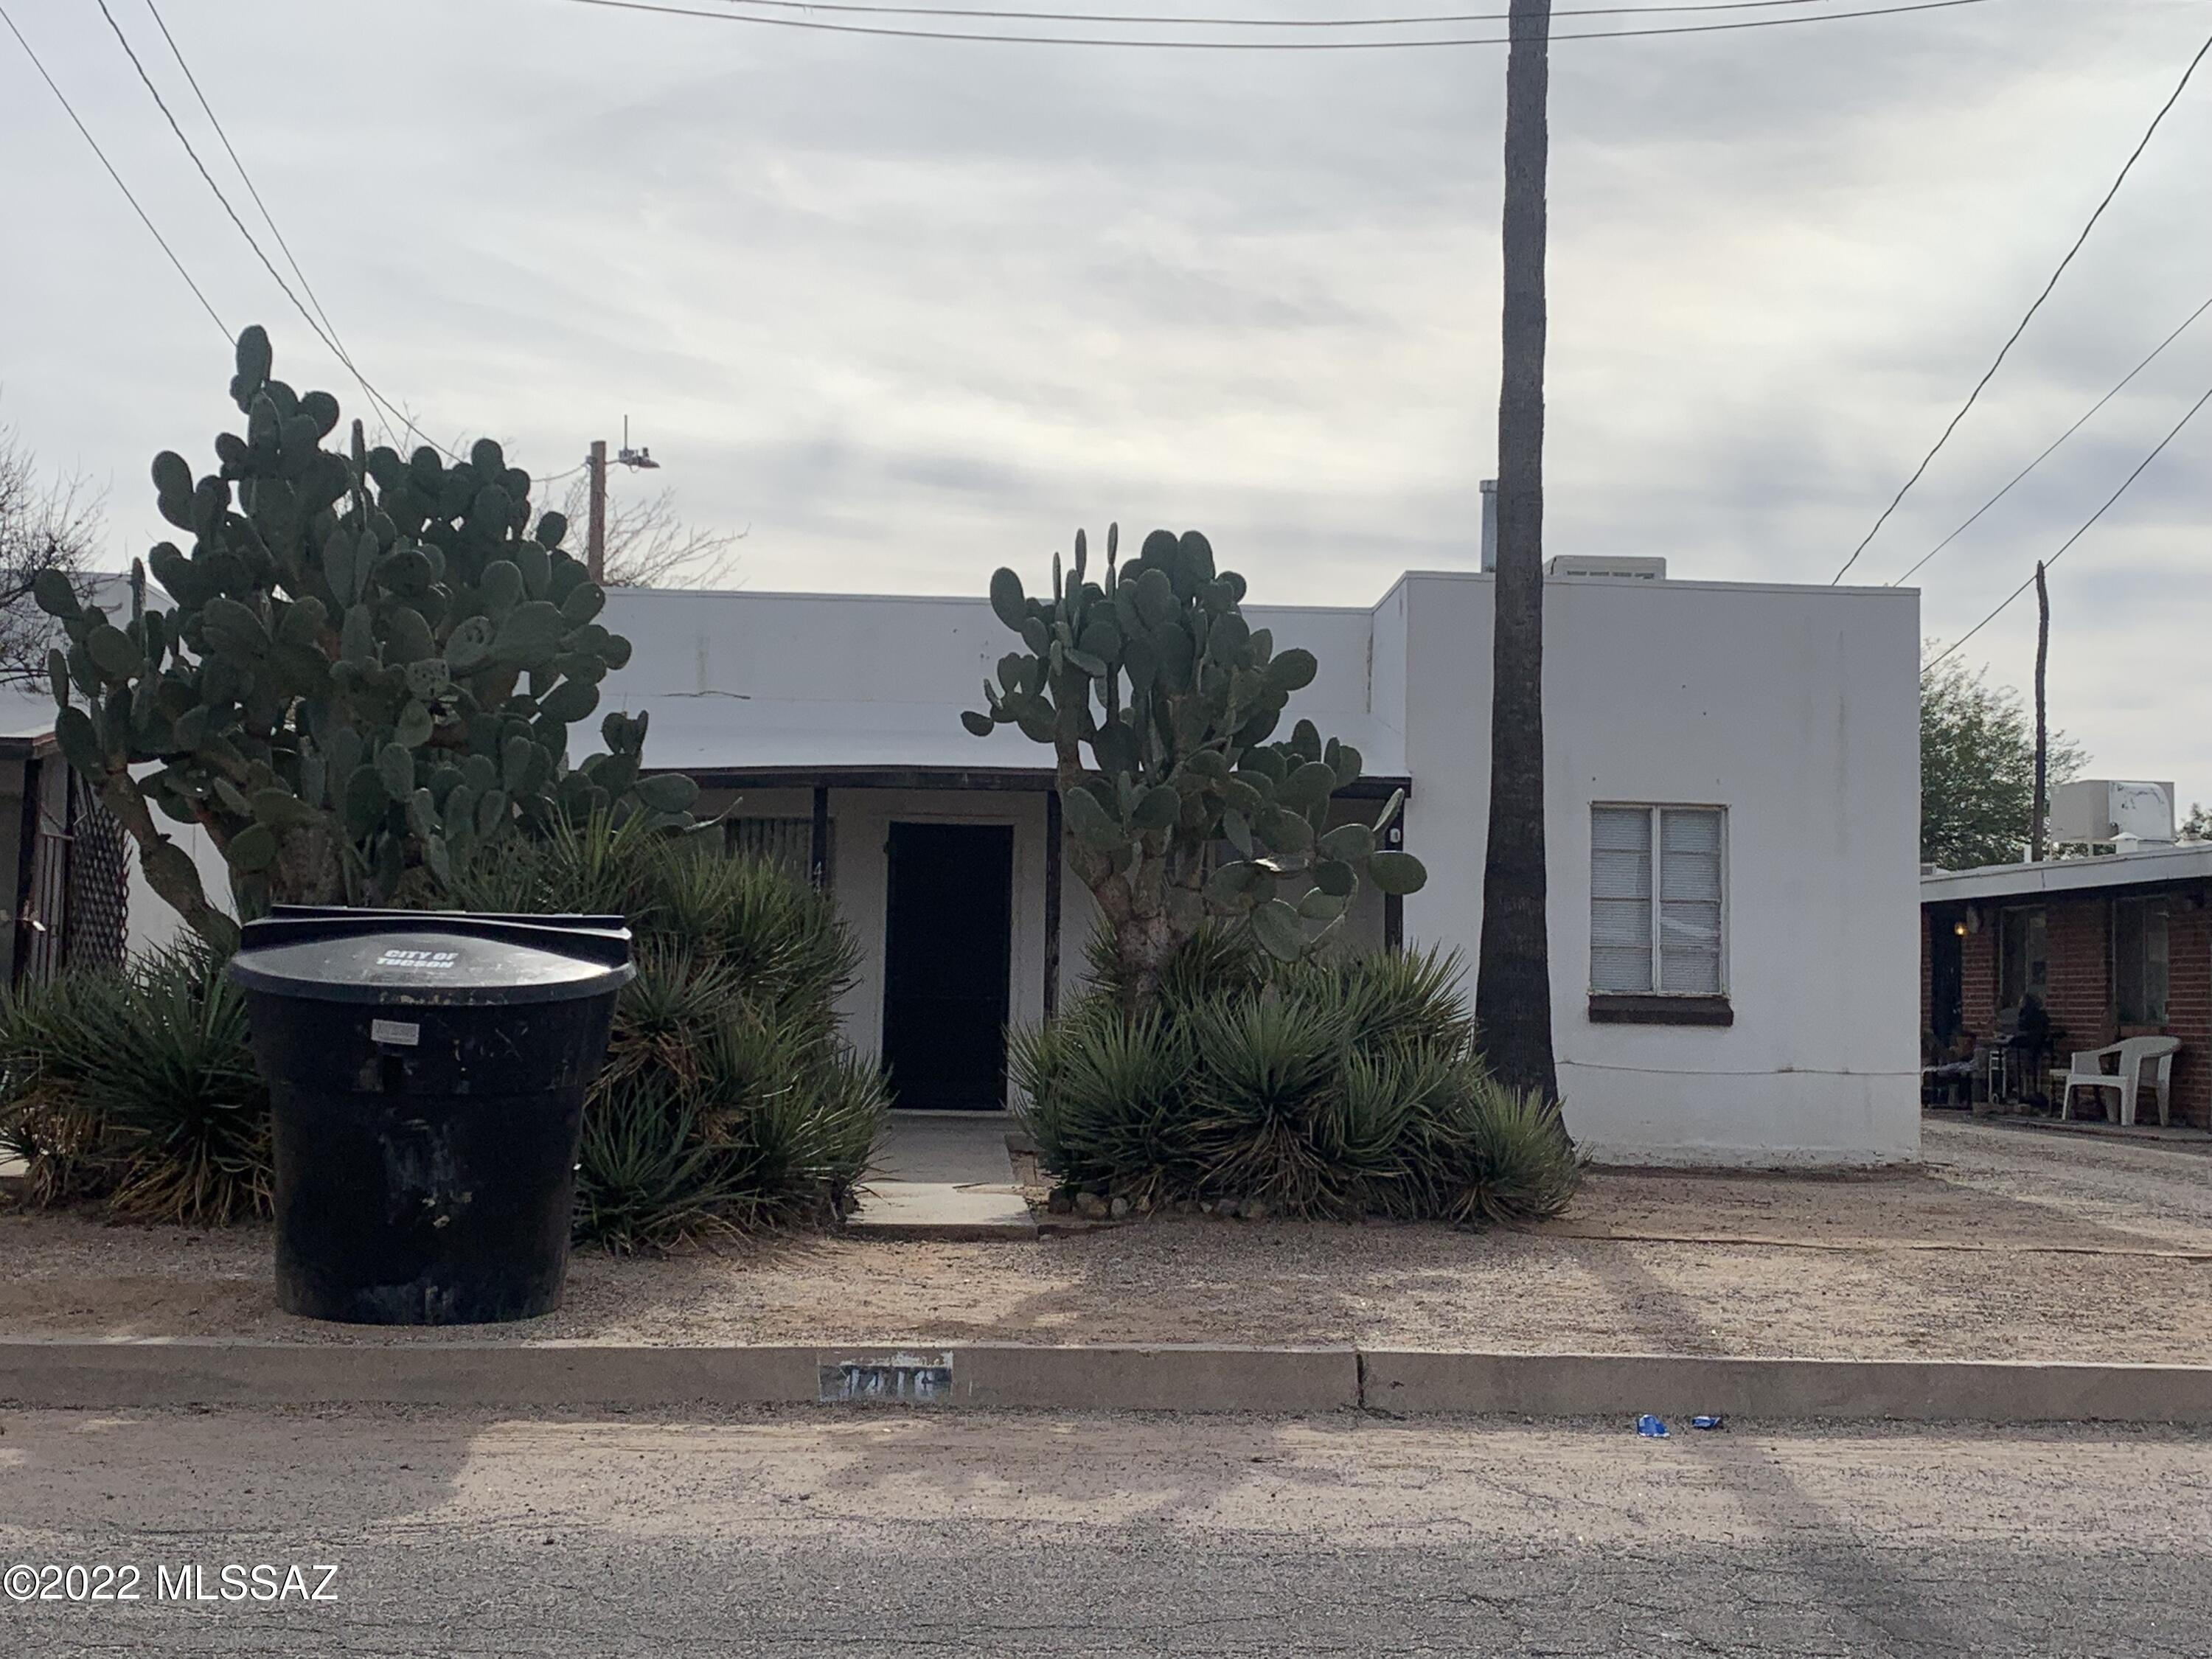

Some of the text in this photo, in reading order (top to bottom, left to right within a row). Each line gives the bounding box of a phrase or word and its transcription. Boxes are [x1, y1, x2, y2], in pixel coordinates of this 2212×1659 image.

[384, 949, 459, 961] CITY OF
[376, 957, 455, 968] TUCSON
